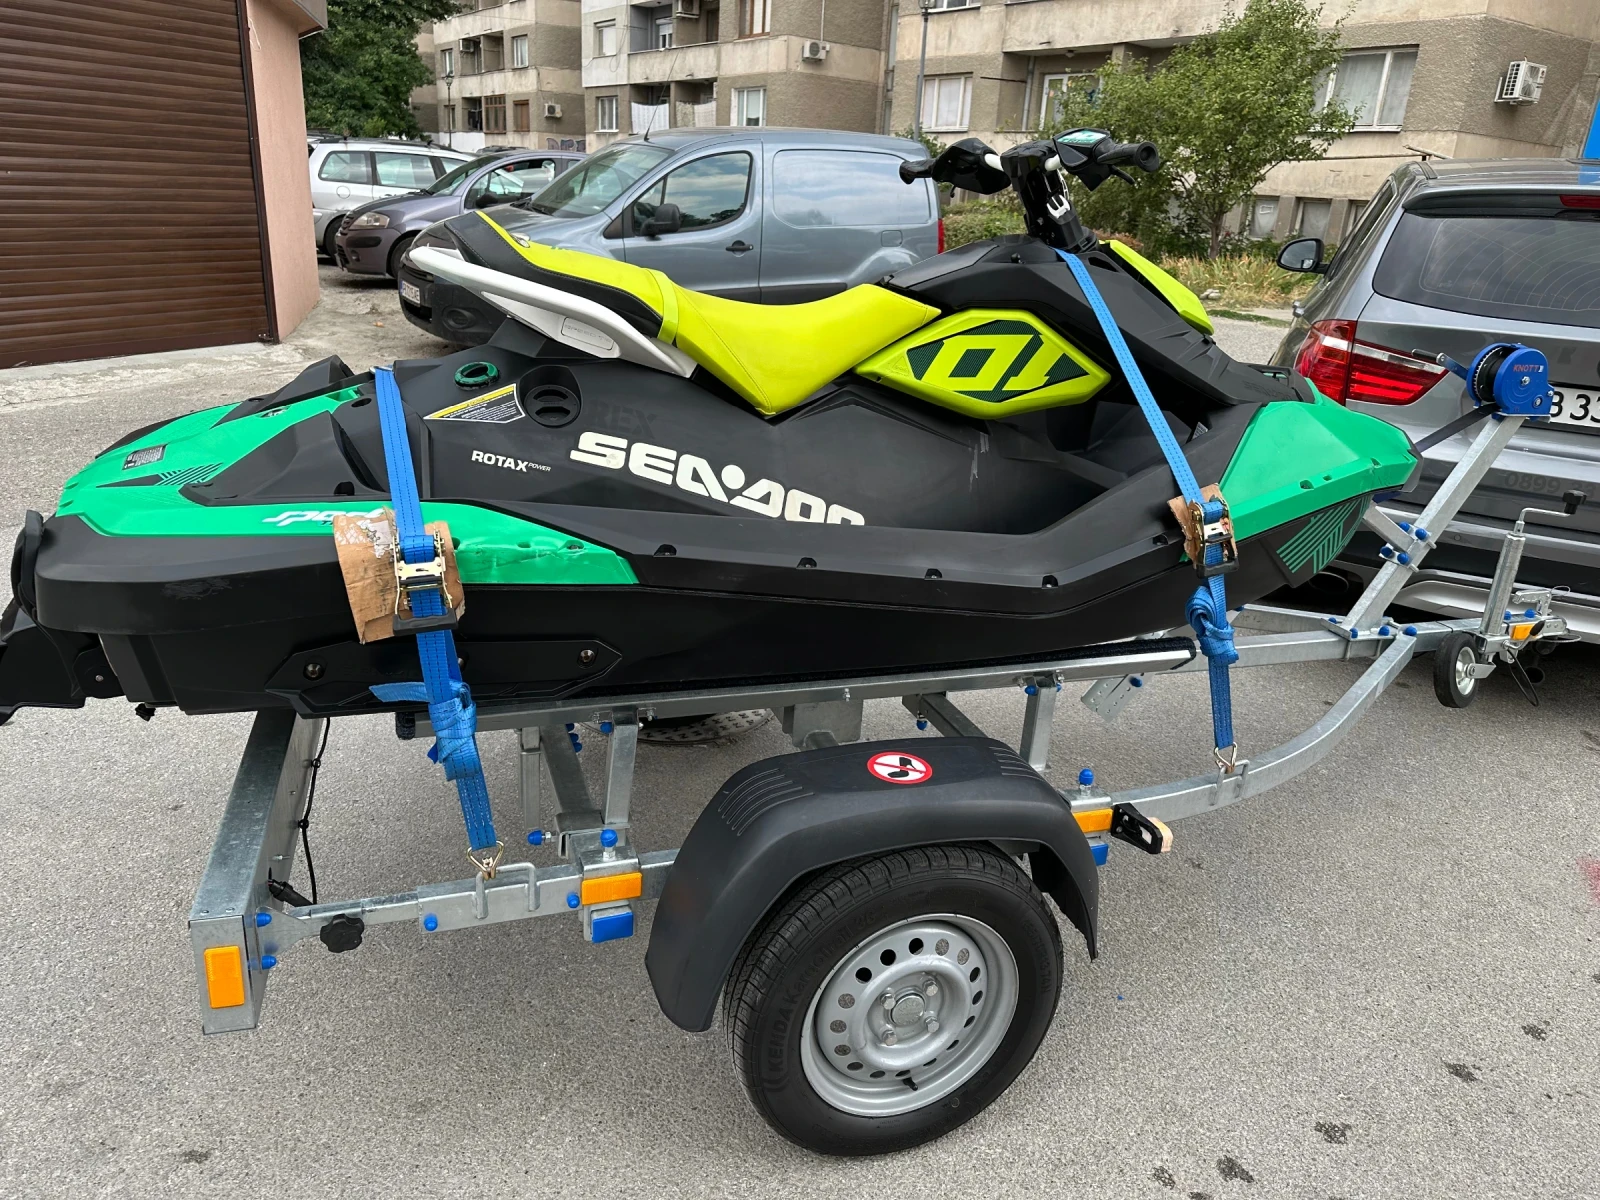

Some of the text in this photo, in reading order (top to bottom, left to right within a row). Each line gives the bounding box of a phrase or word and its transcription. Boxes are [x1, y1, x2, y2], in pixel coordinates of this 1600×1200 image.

[1513, 364, 1539, 373] KNOTT
[471, 450, 552, 472] ROTAX POWER
[1506, 472, 1560, 494] 0899
[767, 1007, 794, 1073] KENDA
